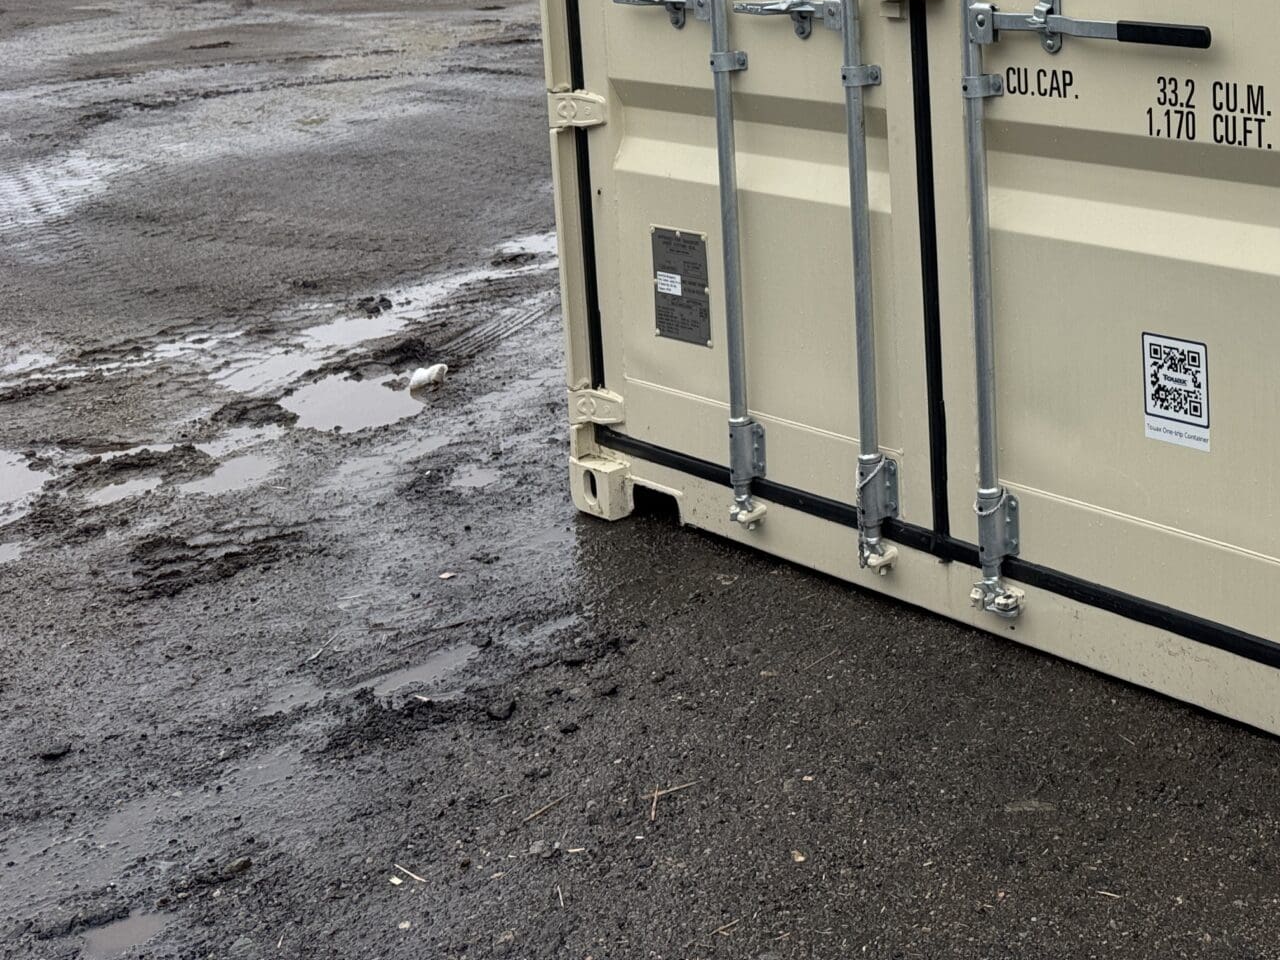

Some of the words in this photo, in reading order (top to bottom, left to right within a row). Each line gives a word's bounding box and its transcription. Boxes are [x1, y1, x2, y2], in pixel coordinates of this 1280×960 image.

[1005, 66, 1079, 100] CU.CAP.
[1156, 76, 1196, 109] 33.2
[1212, 81, 1272, 117] CU.M.
[1146, 106, 1196, 141] 1,170
[1212, 113, 1272, 150] CU.FT.
